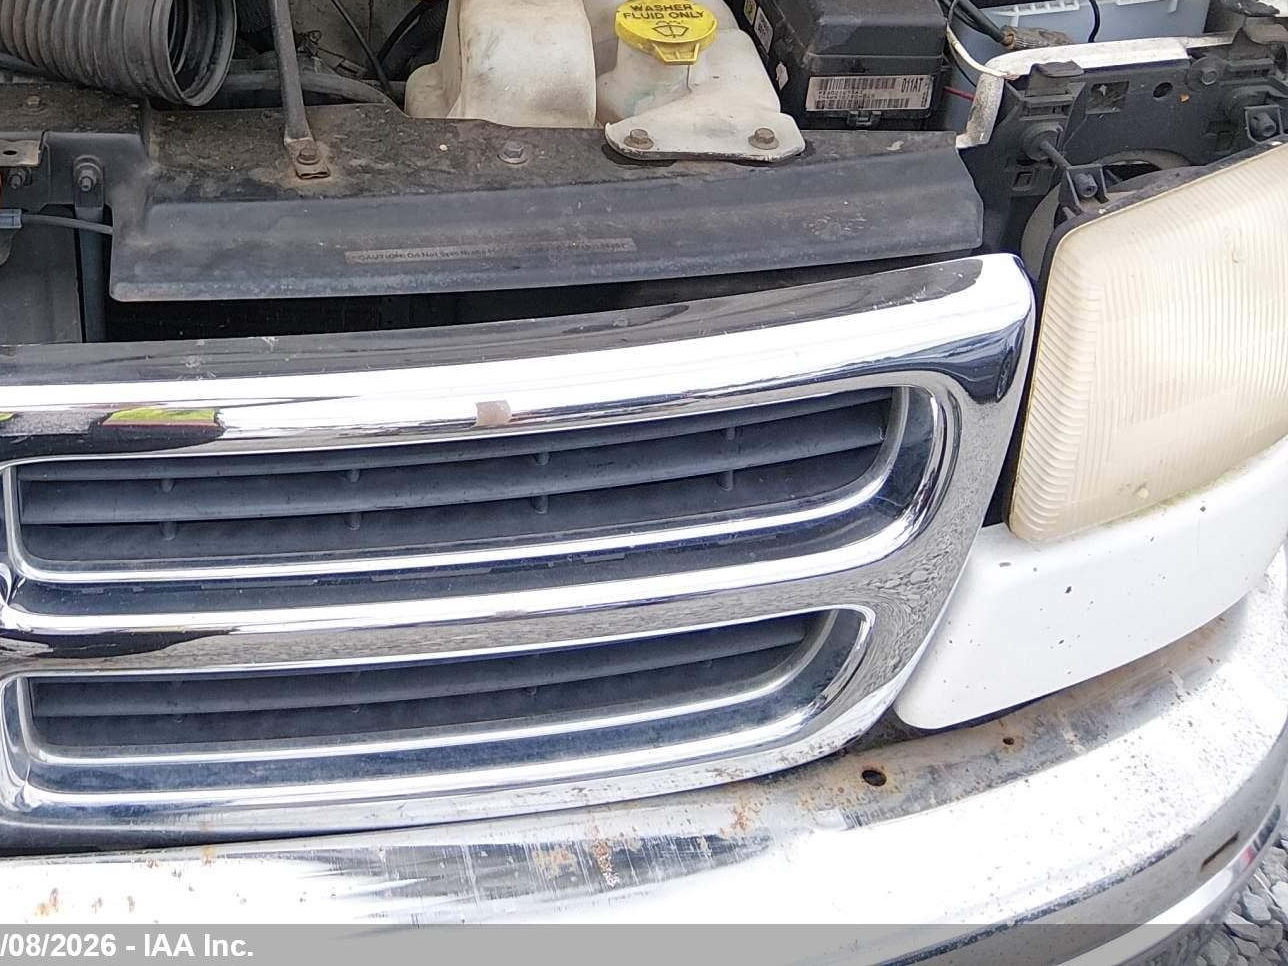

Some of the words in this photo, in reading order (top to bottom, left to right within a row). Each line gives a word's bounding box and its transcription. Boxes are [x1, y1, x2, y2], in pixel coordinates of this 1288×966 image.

[630, 4, 693, 12] WASHER
[623, 12, 664, 20] FLUID
[669, 10, 704, 20] ONLY
